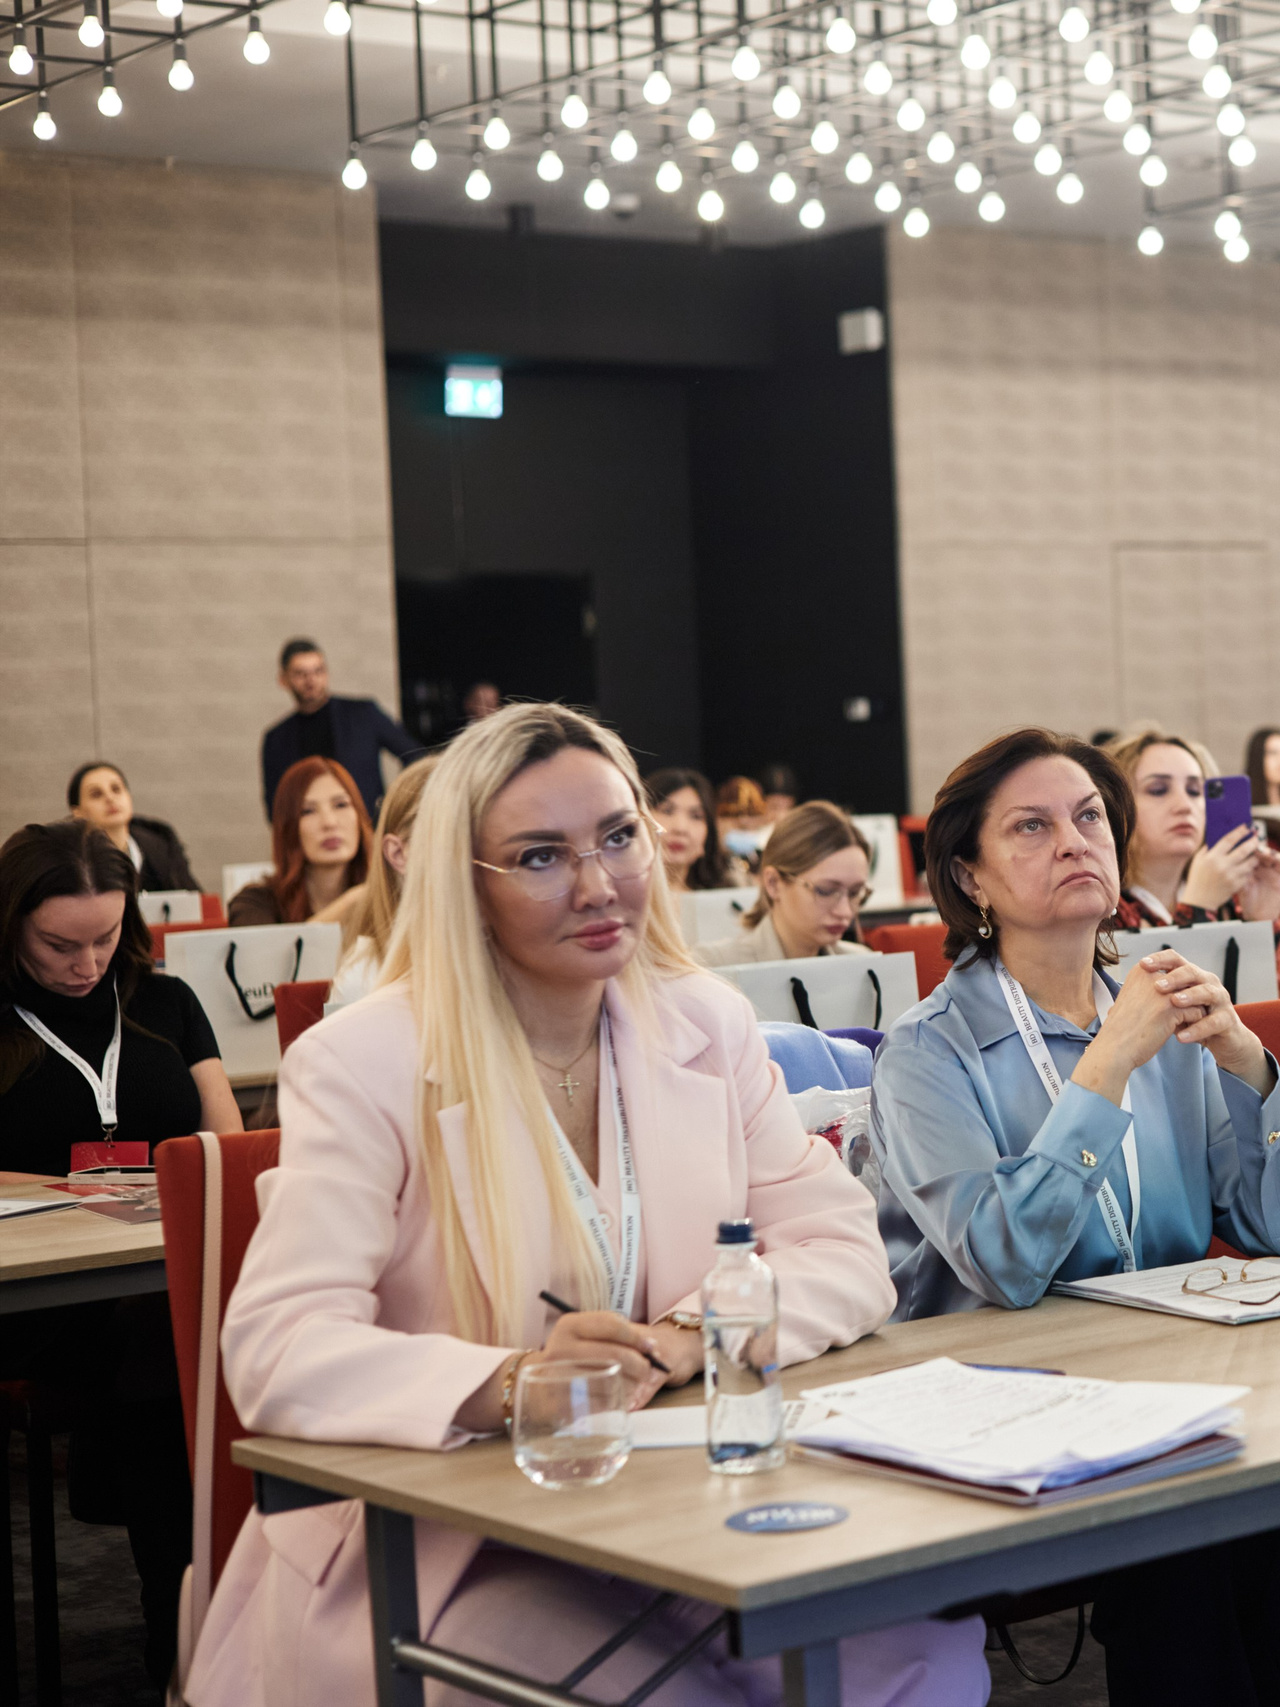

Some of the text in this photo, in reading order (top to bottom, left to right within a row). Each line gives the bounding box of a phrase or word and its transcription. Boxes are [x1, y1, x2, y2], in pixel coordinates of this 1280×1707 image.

[1017, 1004, 1032, 1032] BEAUTY
[1029, 1033, 1038, 1045] BD
[1041, 1062, 1060, 1096] IBUTION
[624, 1144, 632, 1176] BEAUTY
[1100, 1185, 1117, 1218] DISTRIBU
[1112, 1217, 1125, 1248] BEAUTY
[616, 1215, 633, 1310] BEAUTY DISTRIBUTION
